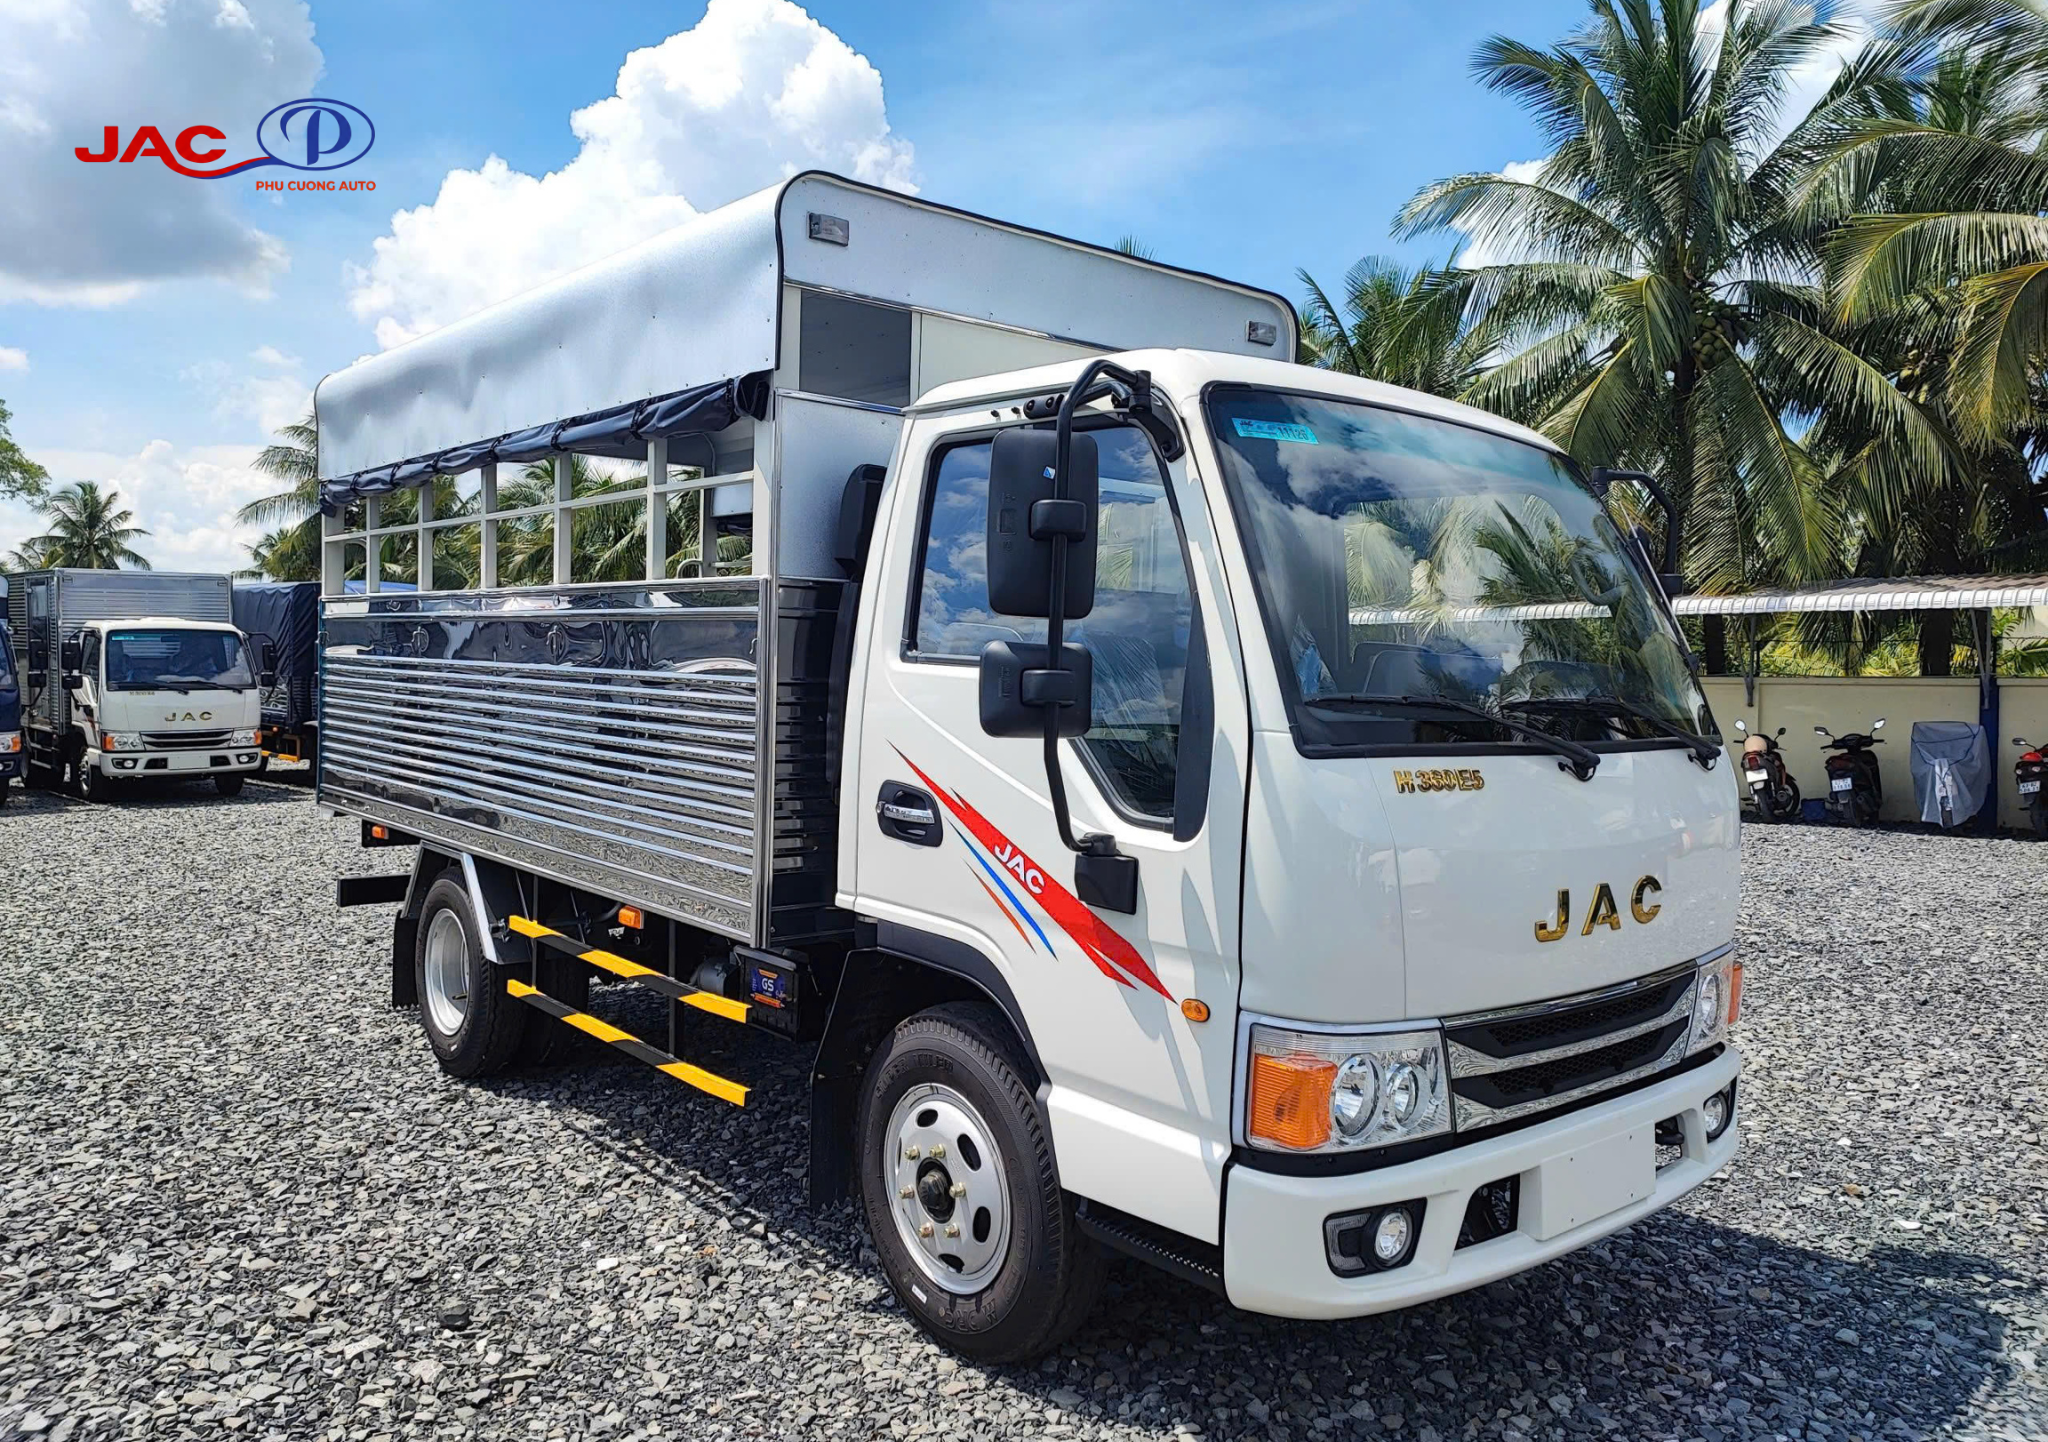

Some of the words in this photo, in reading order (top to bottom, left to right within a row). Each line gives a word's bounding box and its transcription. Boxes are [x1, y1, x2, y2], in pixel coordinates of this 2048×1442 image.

[164, 711, 213, 721] JAC
[994, 843, 1046, 894] JAC
[1534, 875, 1663, 943] JAC
[761, 978, 774, 992] GS
